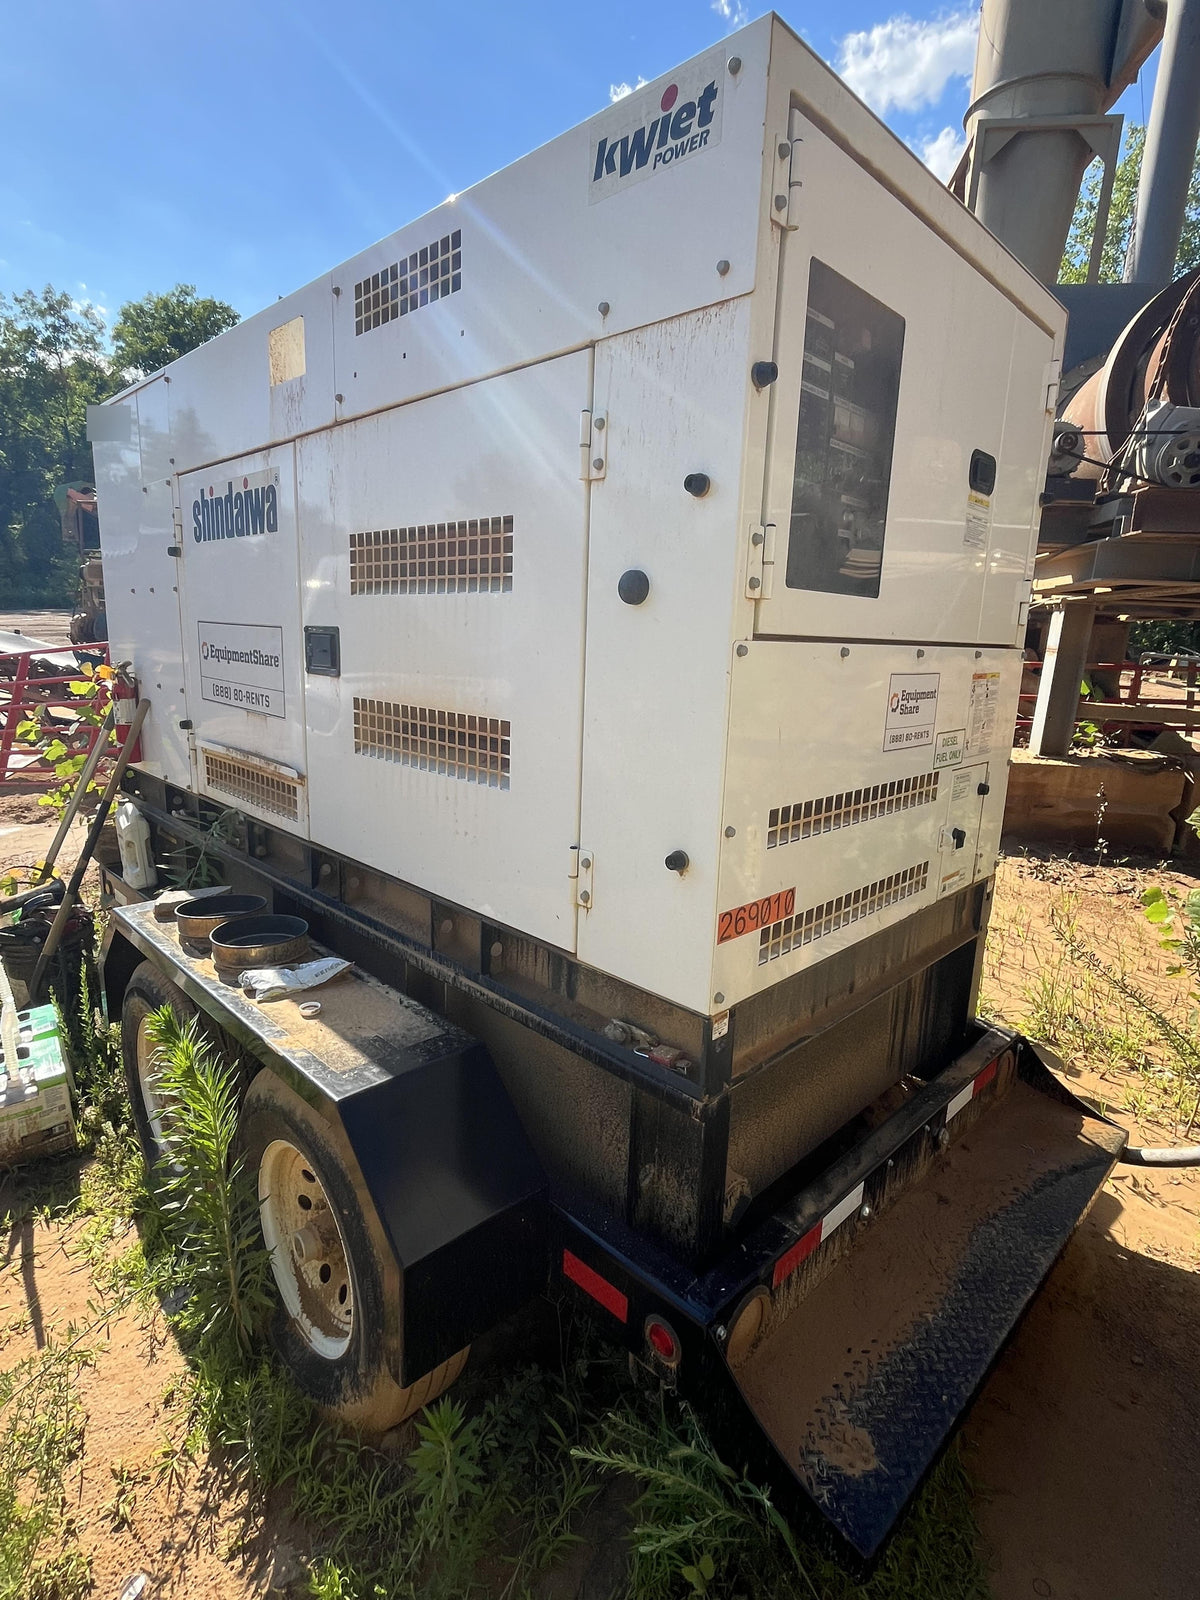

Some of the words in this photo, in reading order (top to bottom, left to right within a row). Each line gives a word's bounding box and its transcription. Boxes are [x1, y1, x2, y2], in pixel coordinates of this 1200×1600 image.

[653, 129, 710, 170] POWER
[193, 477, 278, 543] shindaiwa
[210, 644, 279, 667] EquipmentShare
[213, 683, 231, 700] (888)
[233, 688, 270, 708] 80-RENTS
[901, 689, 937, 703] Equipment
[900, 704, 920, 715] Share
[942, 736, 958, 747] DIESEL
[936, 752, 948, 763] FUEL
[949, 750, 961, 759] ONLY
[720, 889, 795, 941] 269010
